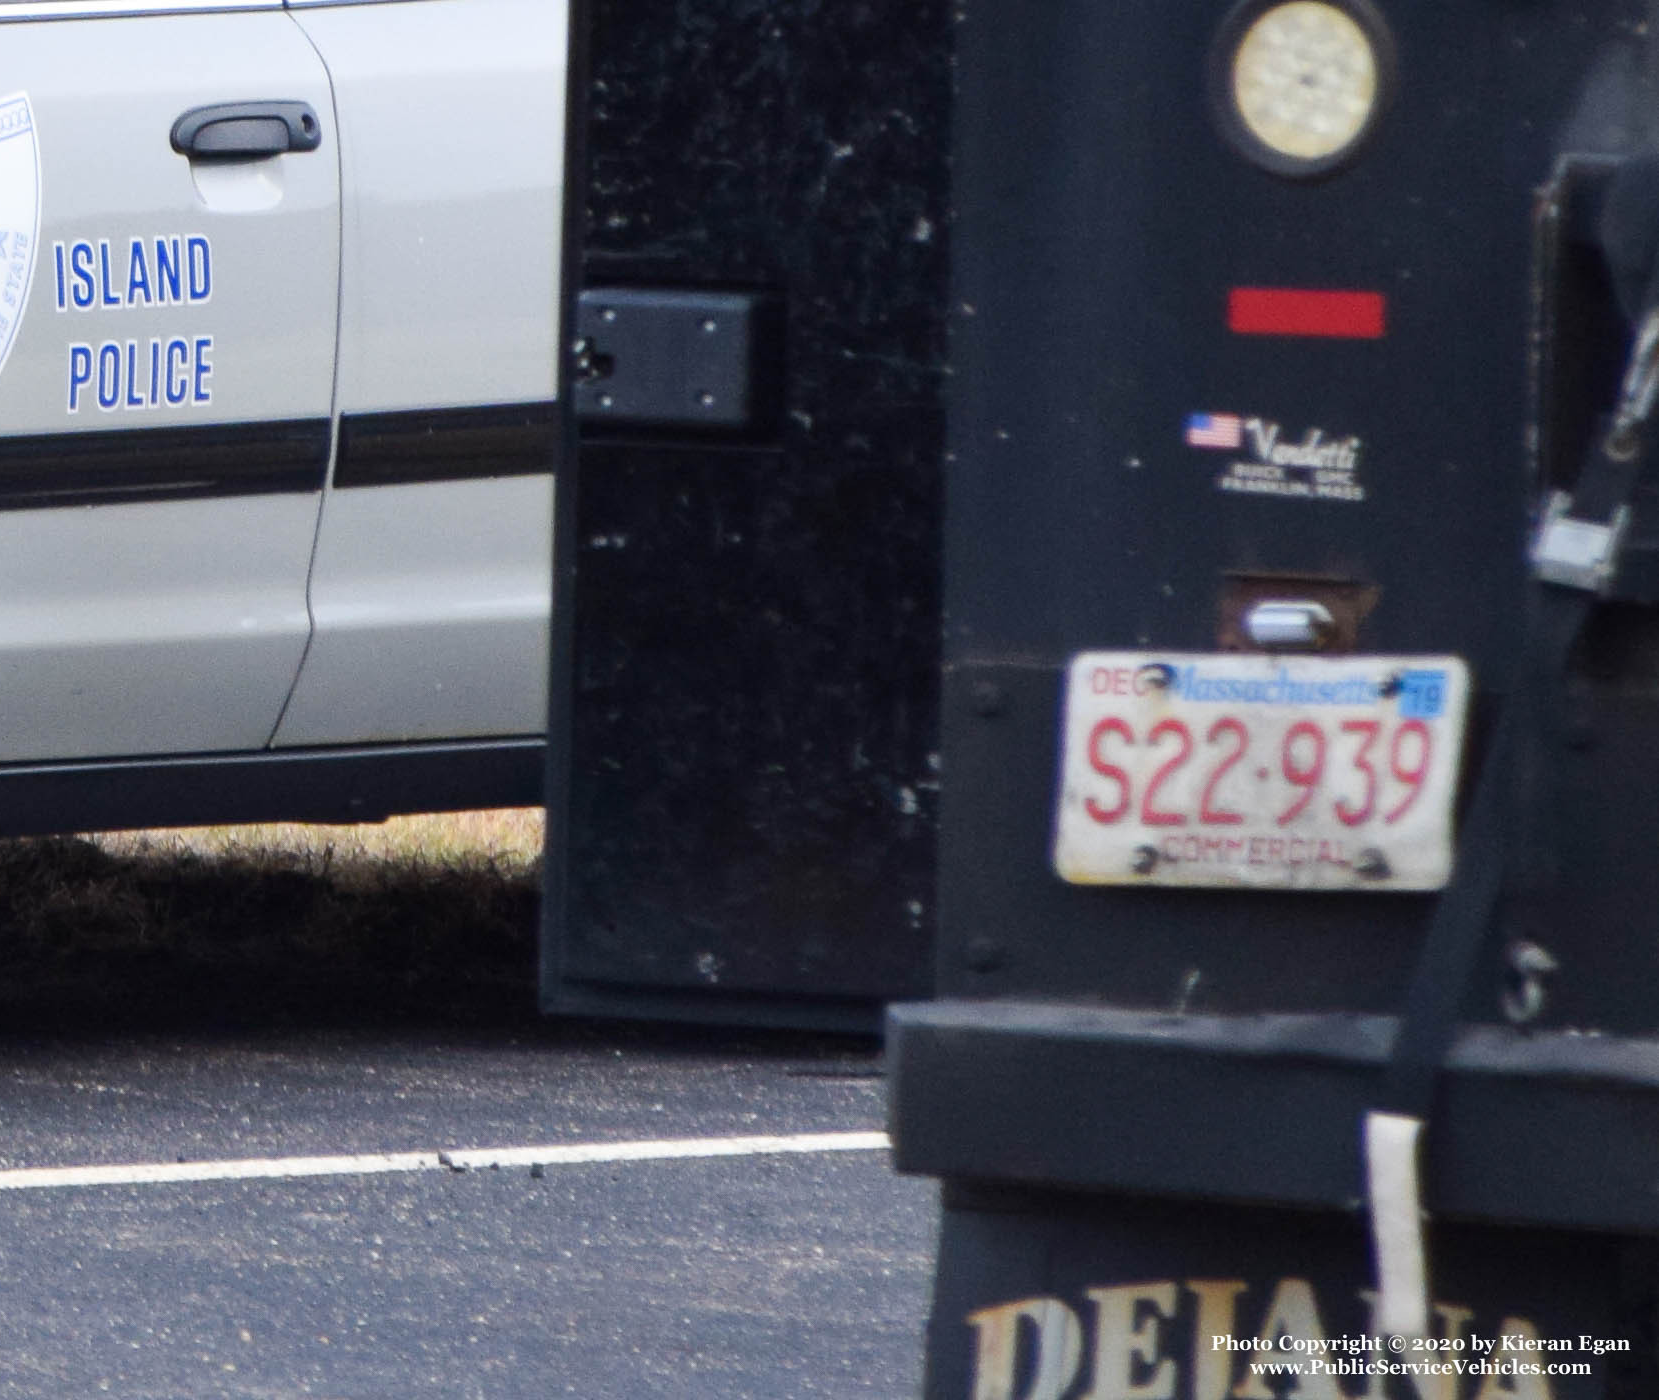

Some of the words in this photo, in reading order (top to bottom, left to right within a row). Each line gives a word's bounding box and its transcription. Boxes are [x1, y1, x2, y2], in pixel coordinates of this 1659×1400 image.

[54, 235, 212, 312] ISLAND
[68, 337, 213, 414] POLICE
[1161, 835, 1354, 868] COMMERCIAL
